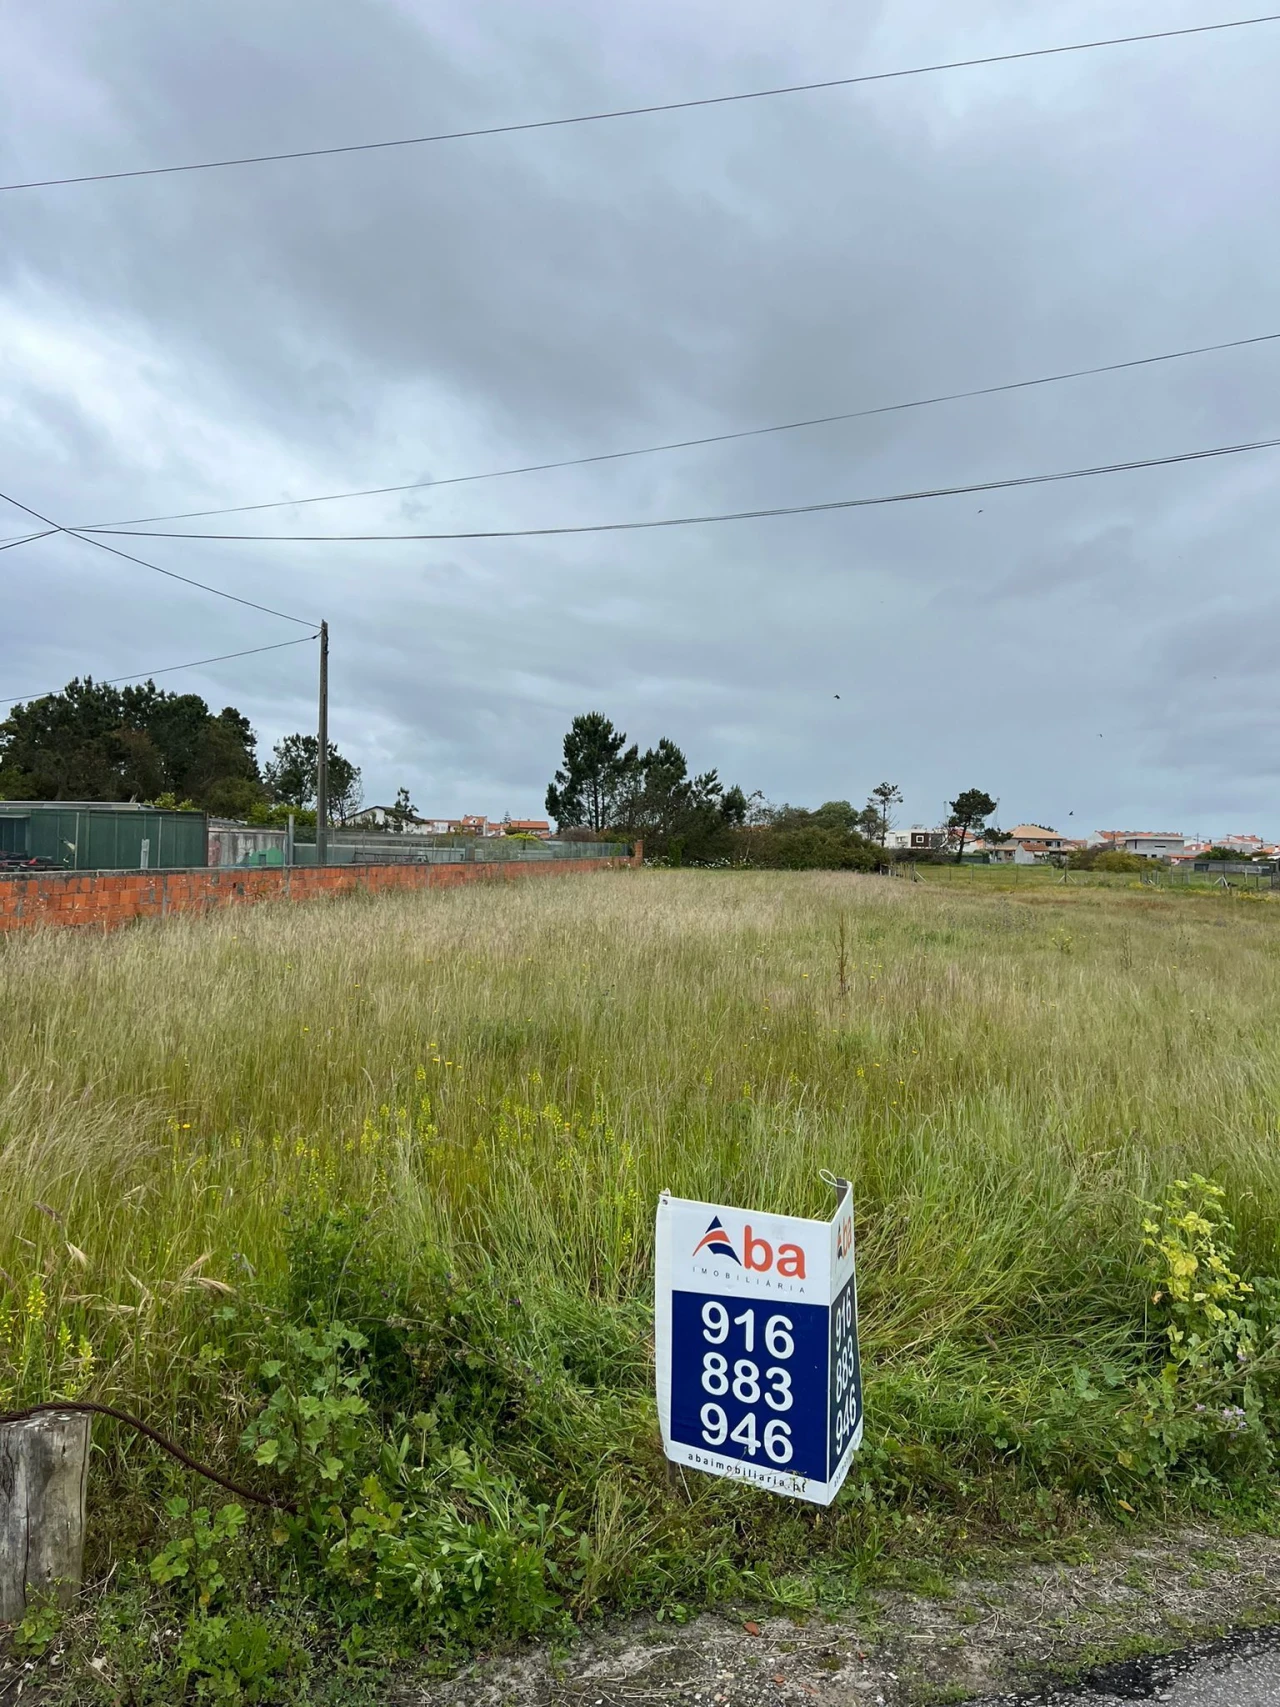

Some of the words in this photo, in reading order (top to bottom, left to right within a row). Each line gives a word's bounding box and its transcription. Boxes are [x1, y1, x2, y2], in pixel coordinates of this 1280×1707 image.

[693, 1216, 806, 1279] Aba
[693, 1267, 805, 1293] IMOBILIÁRIA
[701, 1301, 794, 1359] 916
[836, 1286, 851, 1351] 916
[701, 1352, 794, 1411] 883
[836, 1335, 854, 1403] 883
[700, 1402, 794, 1464] 946
[836, 1383, 856, 1455] 946
[688, 1453, 807, 1492] abaimobiliaria.pt
